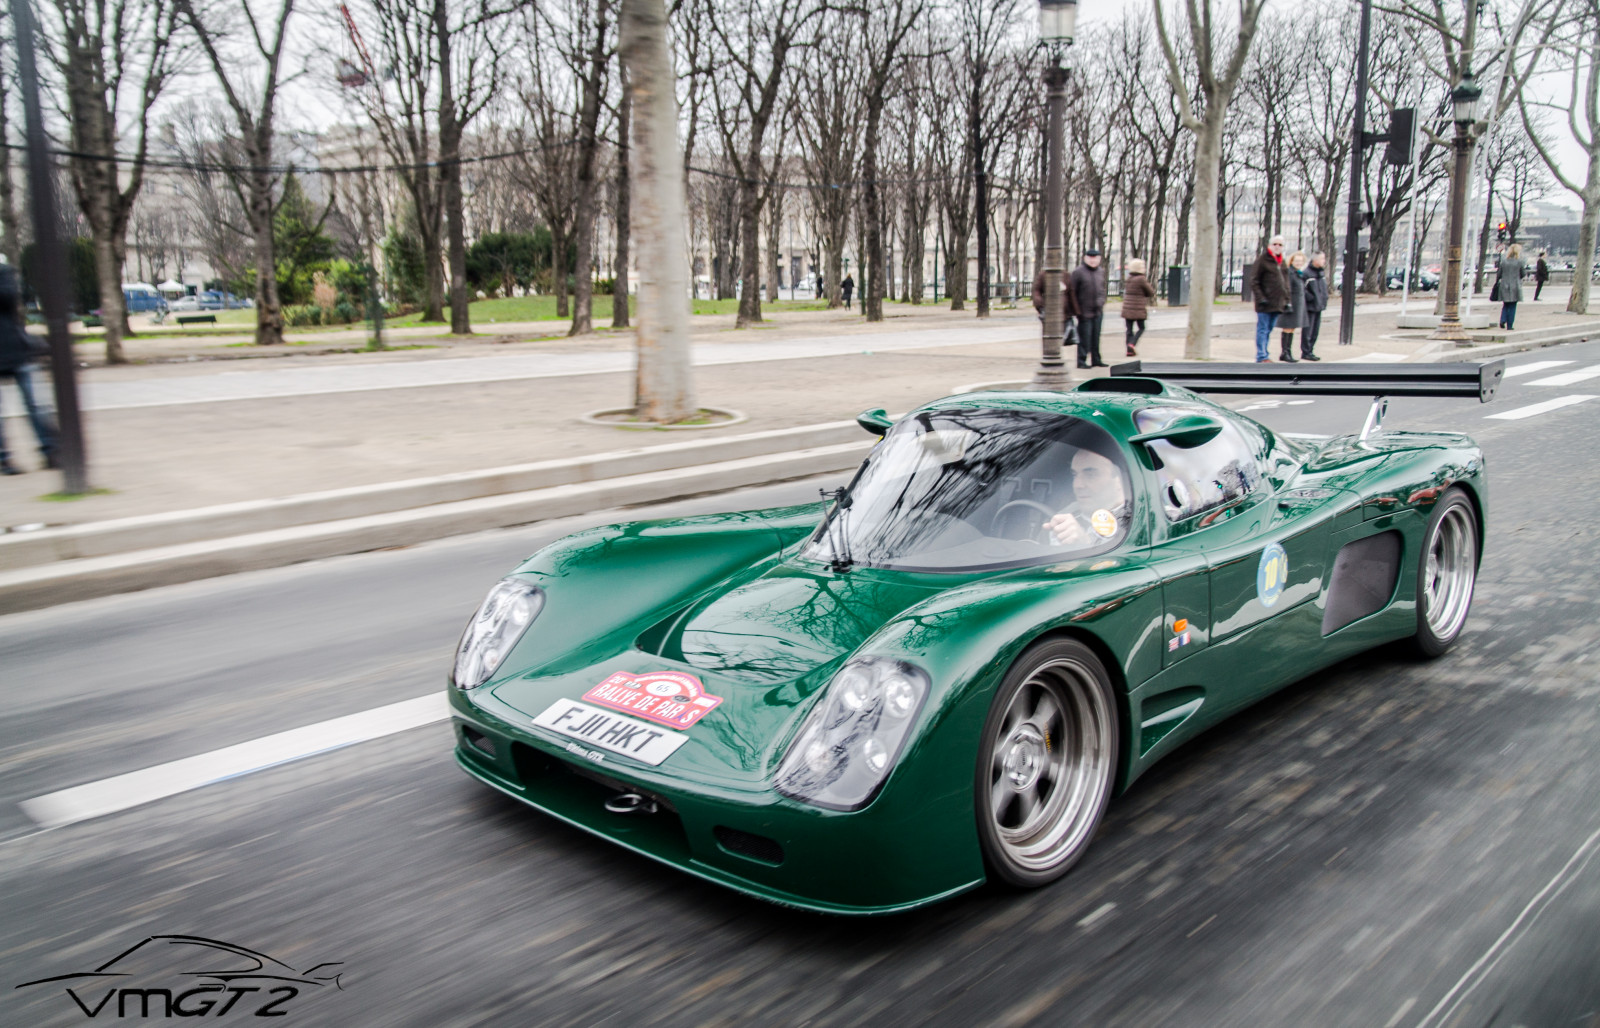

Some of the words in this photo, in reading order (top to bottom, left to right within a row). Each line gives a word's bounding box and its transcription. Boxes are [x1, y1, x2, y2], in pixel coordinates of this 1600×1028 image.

[591, 683, 643, 706] RALLYE
[633, 695, 657, 711] DE
[655, 684, 670, 693] 65
[598, 721, 664, 752] HKT
